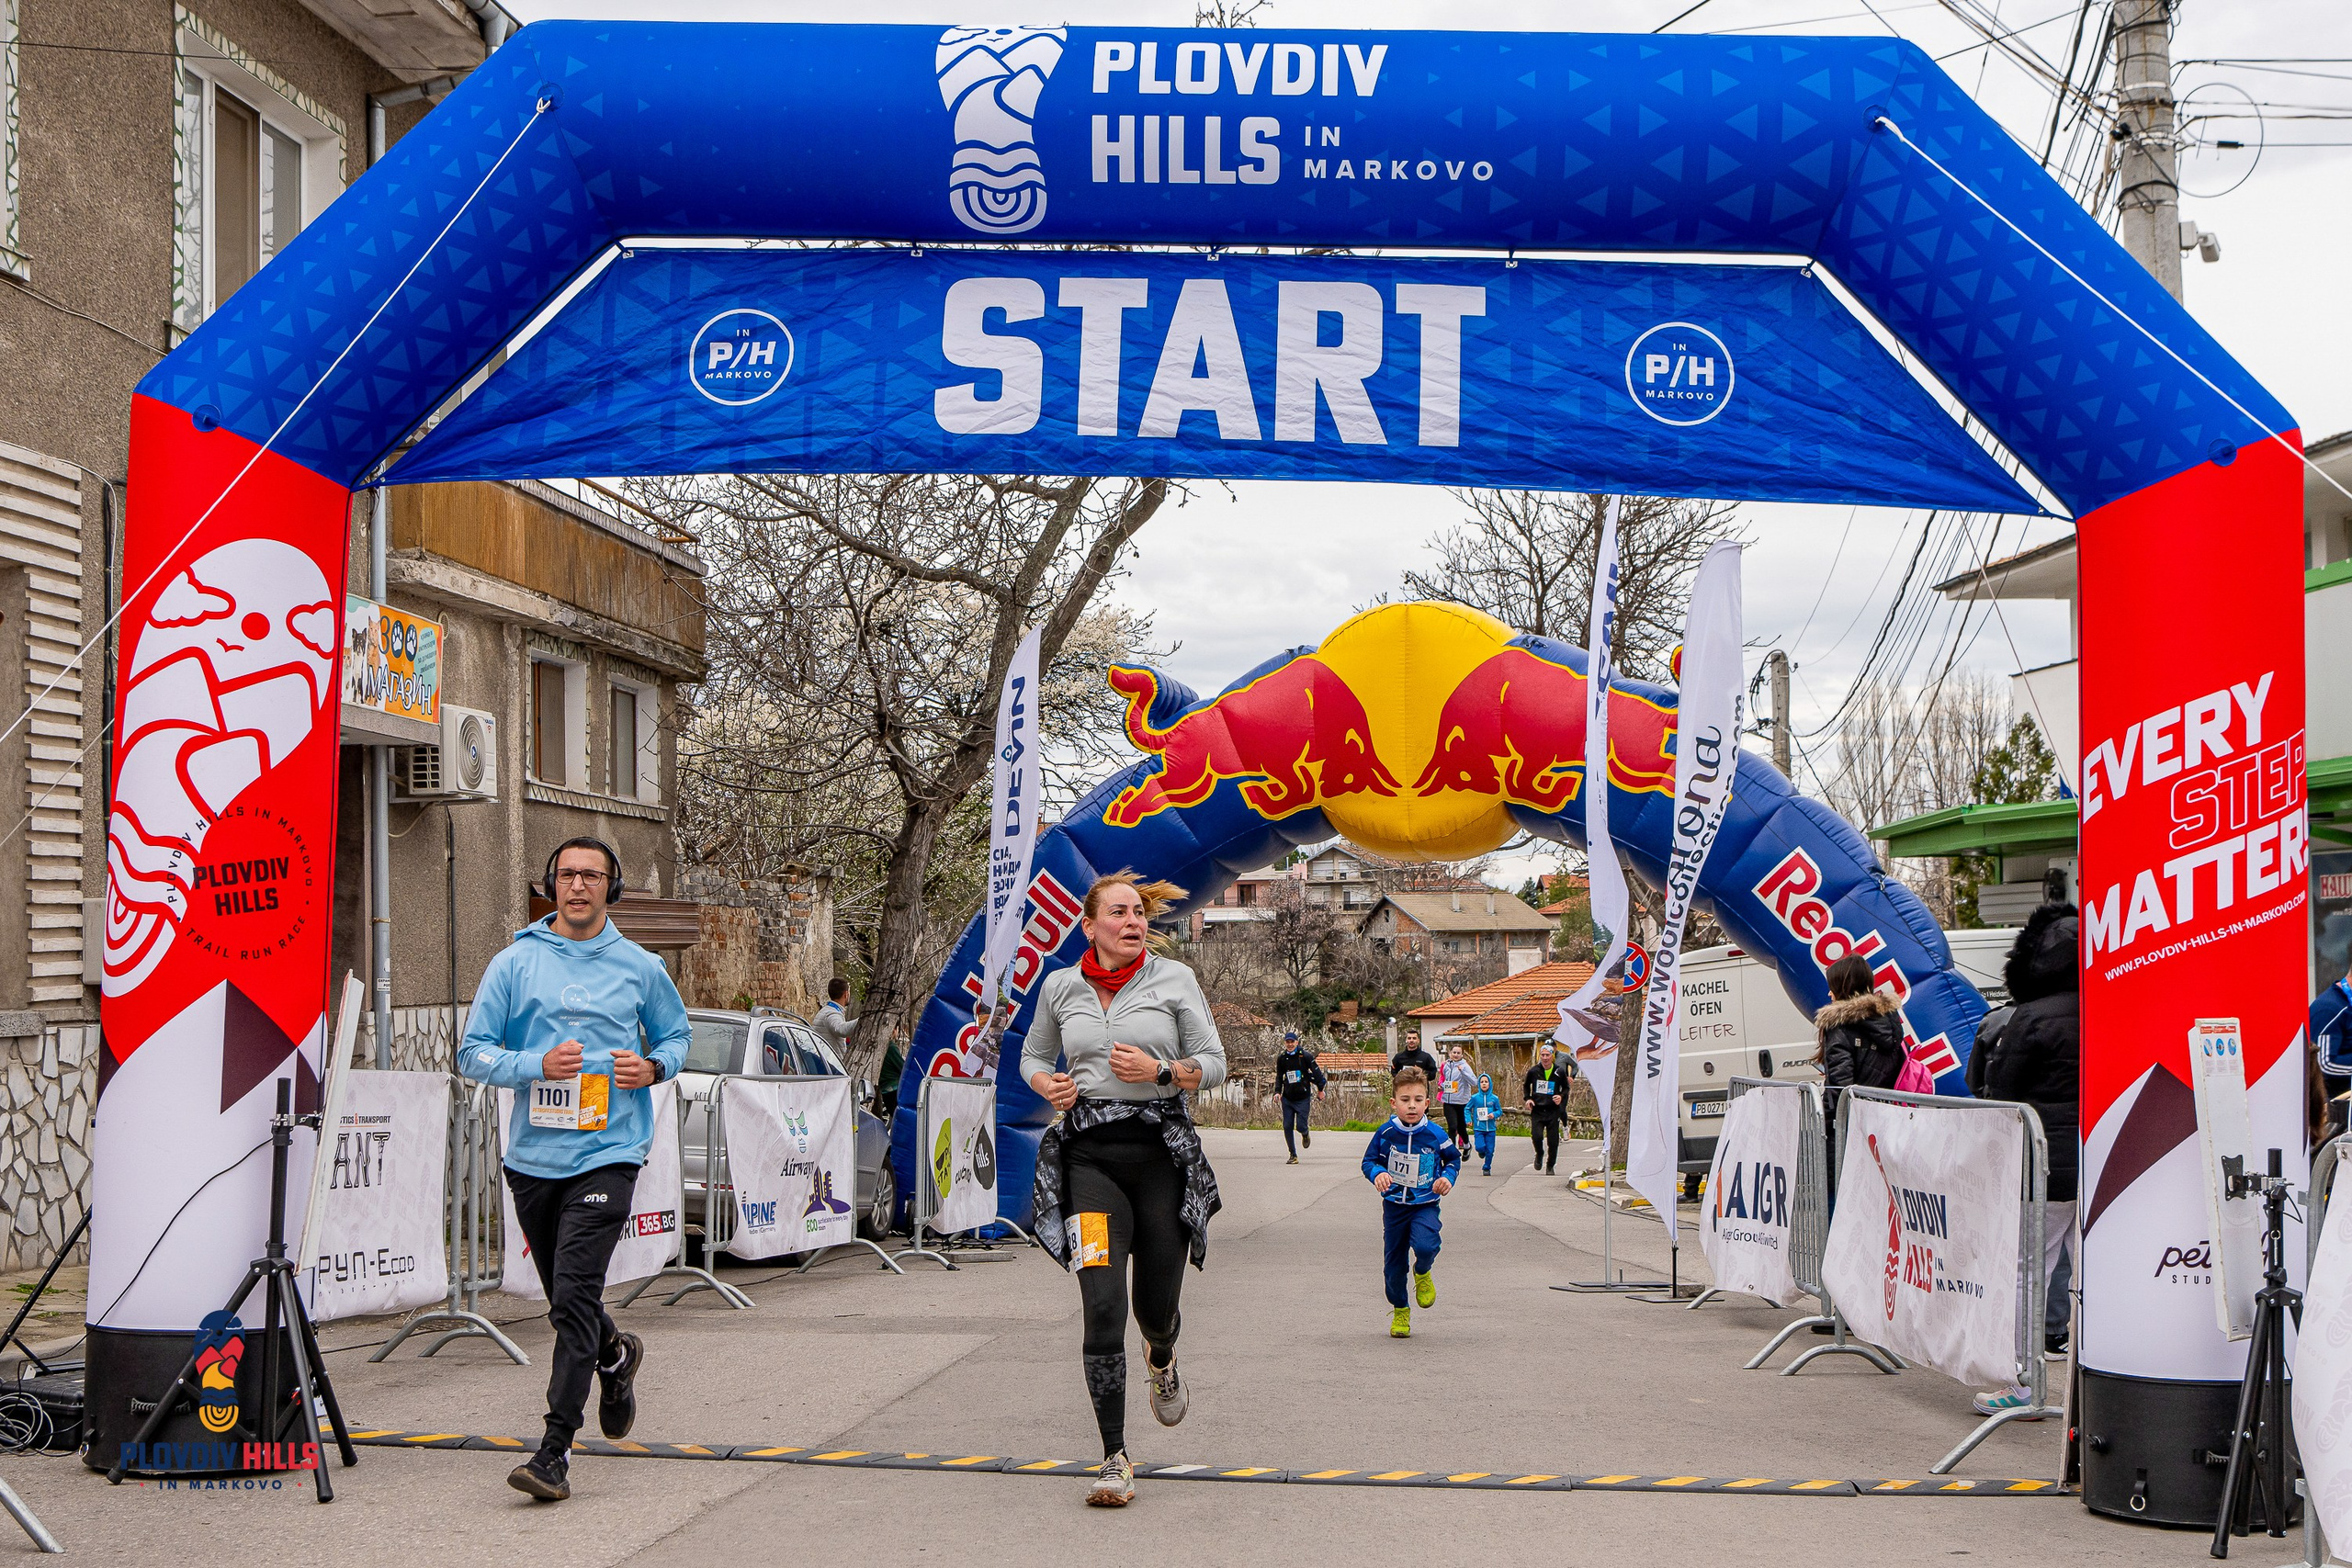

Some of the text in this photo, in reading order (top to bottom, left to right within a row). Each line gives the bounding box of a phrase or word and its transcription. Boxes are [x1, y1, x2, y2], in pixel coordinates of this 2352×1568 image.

[1092, 41, 1389, 96] PLOVDIV
[1304, 126, 1341, 147] IN
[1091, 115, 1281, 185] HILLS
[1304, 159, 1494, 181] MARKOVO
[736, 329, 750, 337] IN
[708, 341, 776, 369] P/H
[1673, 343, 1687, 351] IN
[933, 277, 1487, 447] START
[1645, 354, 1714, 388] P/H
[705, 371, 772, 379] MARKOVO
[1645, 389, 1714, 400] MARKOVO
[368, 663, 433, 716] МАГАЗИН
[1005, 675, 1025, 838] DEVIN
[2083, 671, 2275, 825] EVERY
[2168, 728, 2306, 850] STEP
[166, 806, 312, 903] PLOVDIV HILLS IN MARKOVO
[192, 856, 289, 890] PLOVDIV
[214, 887, 279, 917] HILLS
[1756, 851, 1881, 972] Red
[186, 915, 306, 961] TRAIL RUN RACE
[2104, 889, 2306, 982] WWW.PLOVDIV-HILLS-IN-MARKOVO.COM
[1682, 980, 1729, 998] KACHEL
[1690, 1000, 1722, 1016] ÖFEN
[1679, 1023, 1736, 1042] LEITER
[1782, 1058, 1815, 1068] DUCAT
[537, 1088, 571, 1107] 1101
[1696, 1102, 1725, 1114] PB 0271
[358, 1115, 390, 1123] TRANSPORT
[330, 1132, 391, 1190] ANT
[1394, 1160, 1410, 1175] 171
[583, 1194, 608, 1203] one
[639, 1213, 675, 1234] 365.BG
[807, 1218, 818, 1233] ECO
[1935, 1257, 1944, 1271] IN
[2172, 1274, 2211, 1284] STUD
